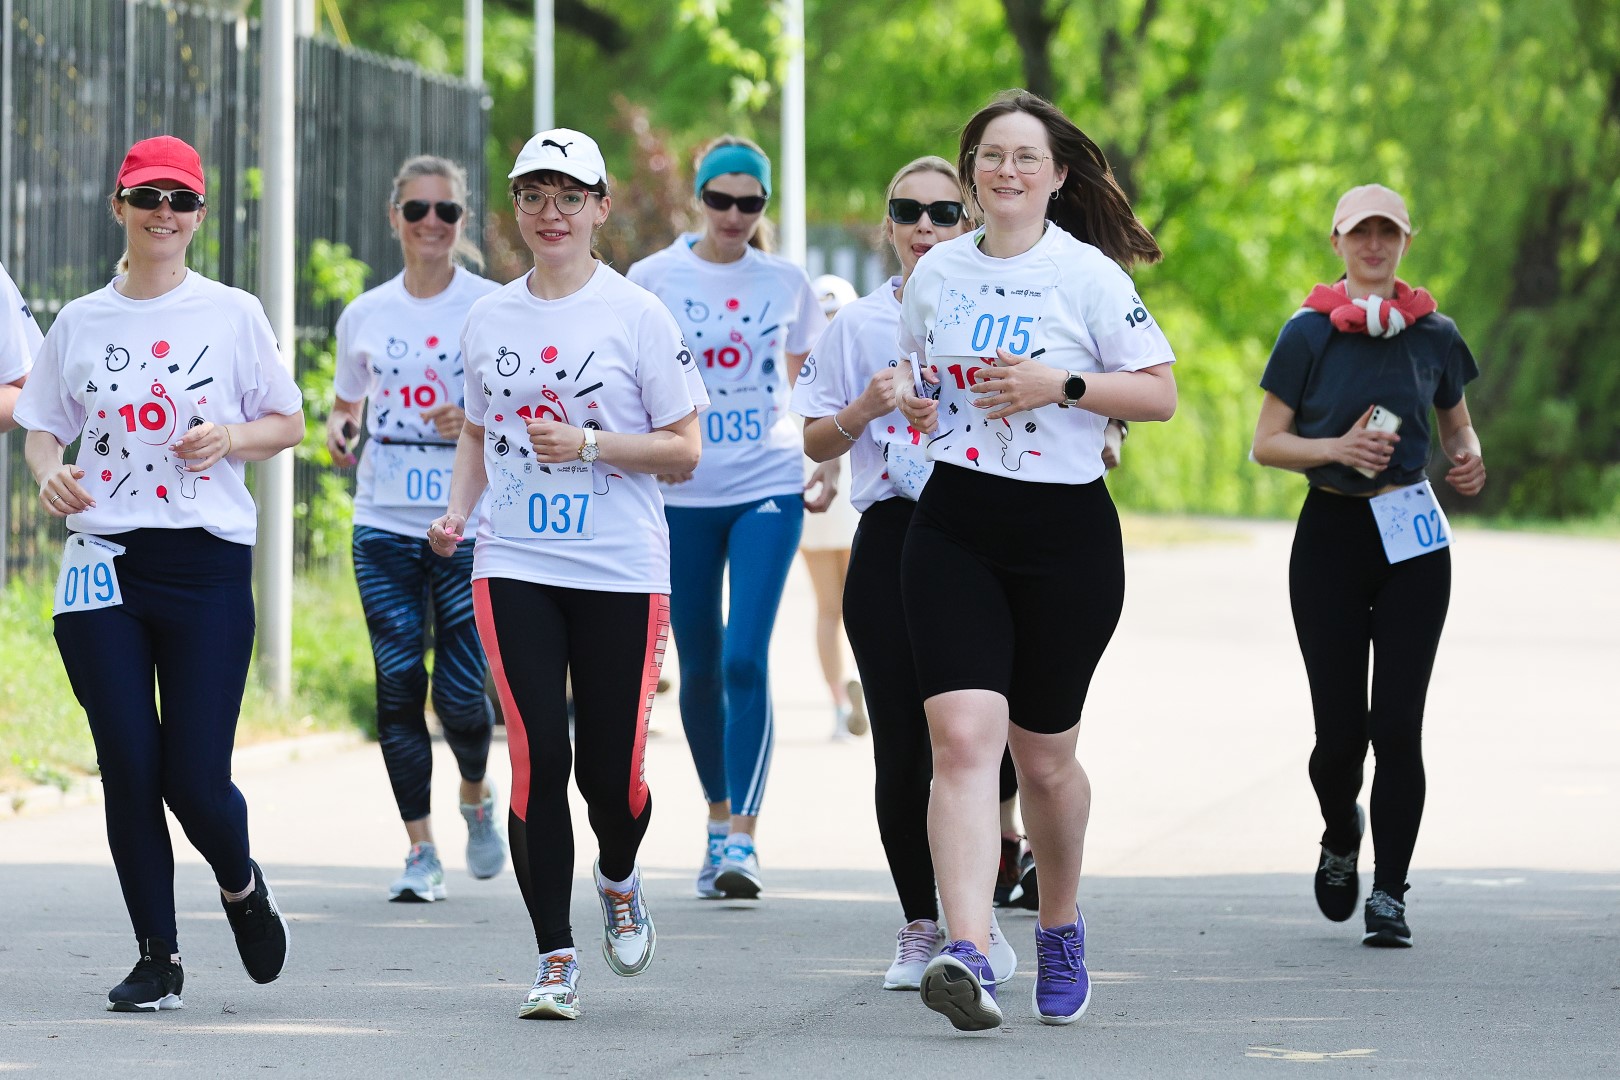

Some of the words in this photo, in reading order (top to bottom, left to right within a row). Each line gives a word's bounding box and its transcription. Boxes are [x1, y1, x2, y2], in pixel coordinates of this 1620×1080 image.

[971, 313, 1034, 355] 015
[1125, 307, 1148, 328] 10
[703, 347, 741, 369] 10
[400, 385, 437, 408] 10
[118, 402, 167, 433] 10
[707, 408, 761, 444] 035
[528, 493, 590, 534] 037
[64, 562, 115, 607] 019
